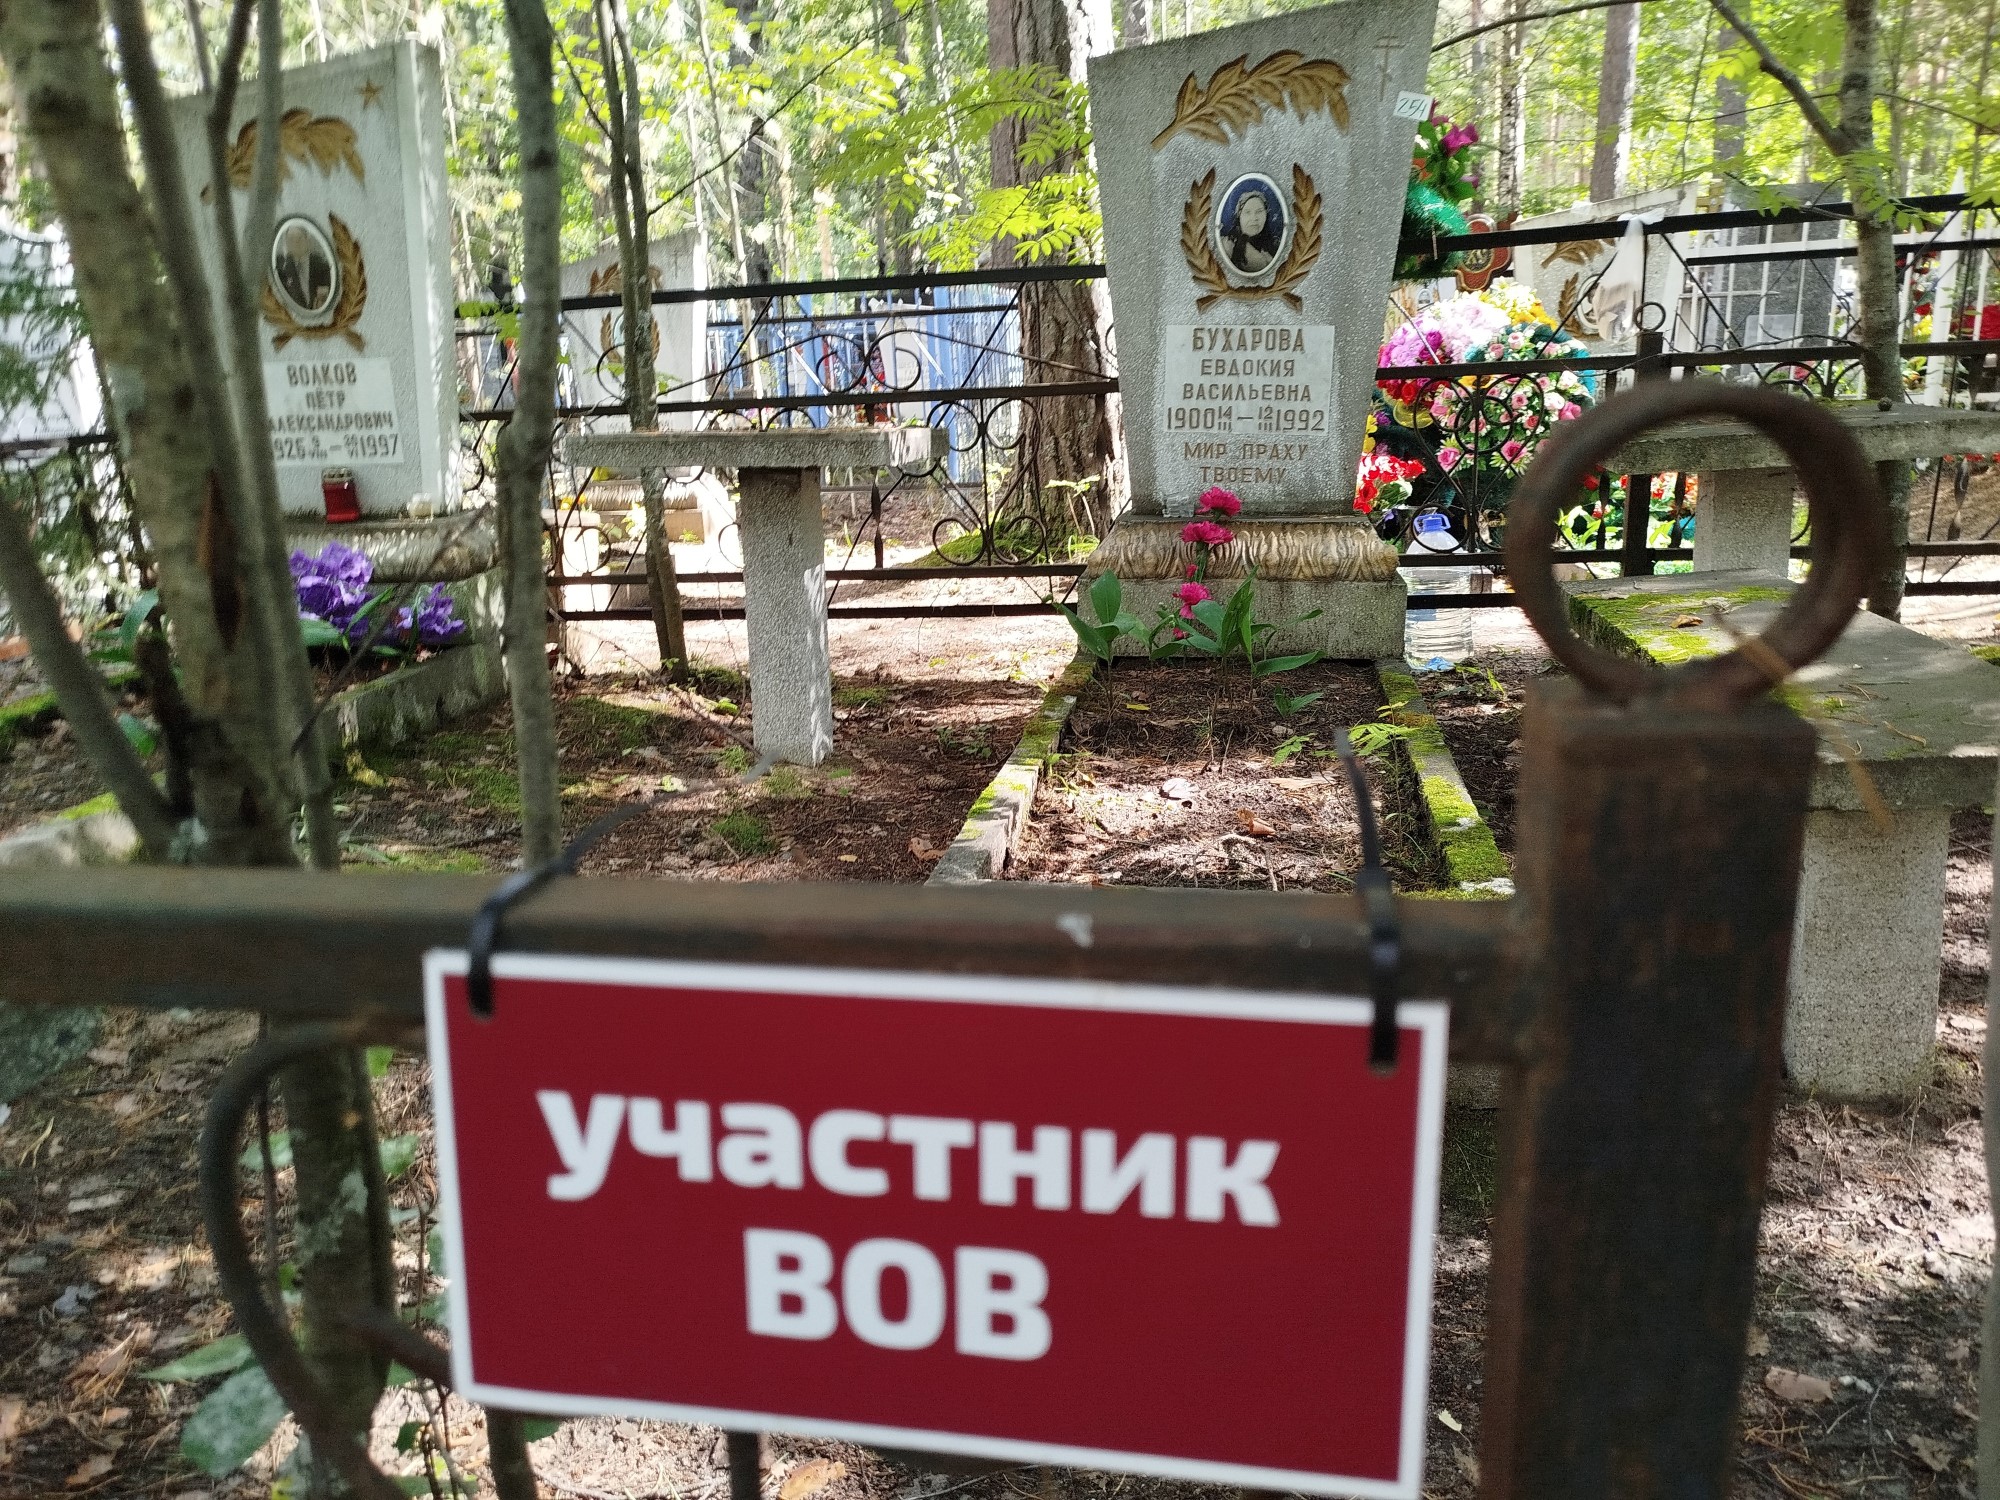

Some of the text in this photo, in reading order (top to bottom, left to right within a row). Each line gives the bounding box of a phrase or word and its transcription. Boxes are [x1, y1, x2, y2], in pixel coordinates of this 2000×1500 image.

[1192, 327, 1306, 353] БУХАРОВА
[287, 362, 357, 387] ВОЛКОВ
[1200, 358, 1295, 377] ЕВДОКИЯ
[1182, 383, 1311, 402] ВАСИЛЬЕВНА
[273, 436, 306, 460] 926
[1183, 442, 1308, 461] МИР ПРАХУ
[1200, 466, 1287, 484] ТВОЕМУ
[535, 1088, 1281, 1228] участник
[742, 1226, 1053, 1362] ВОВ
